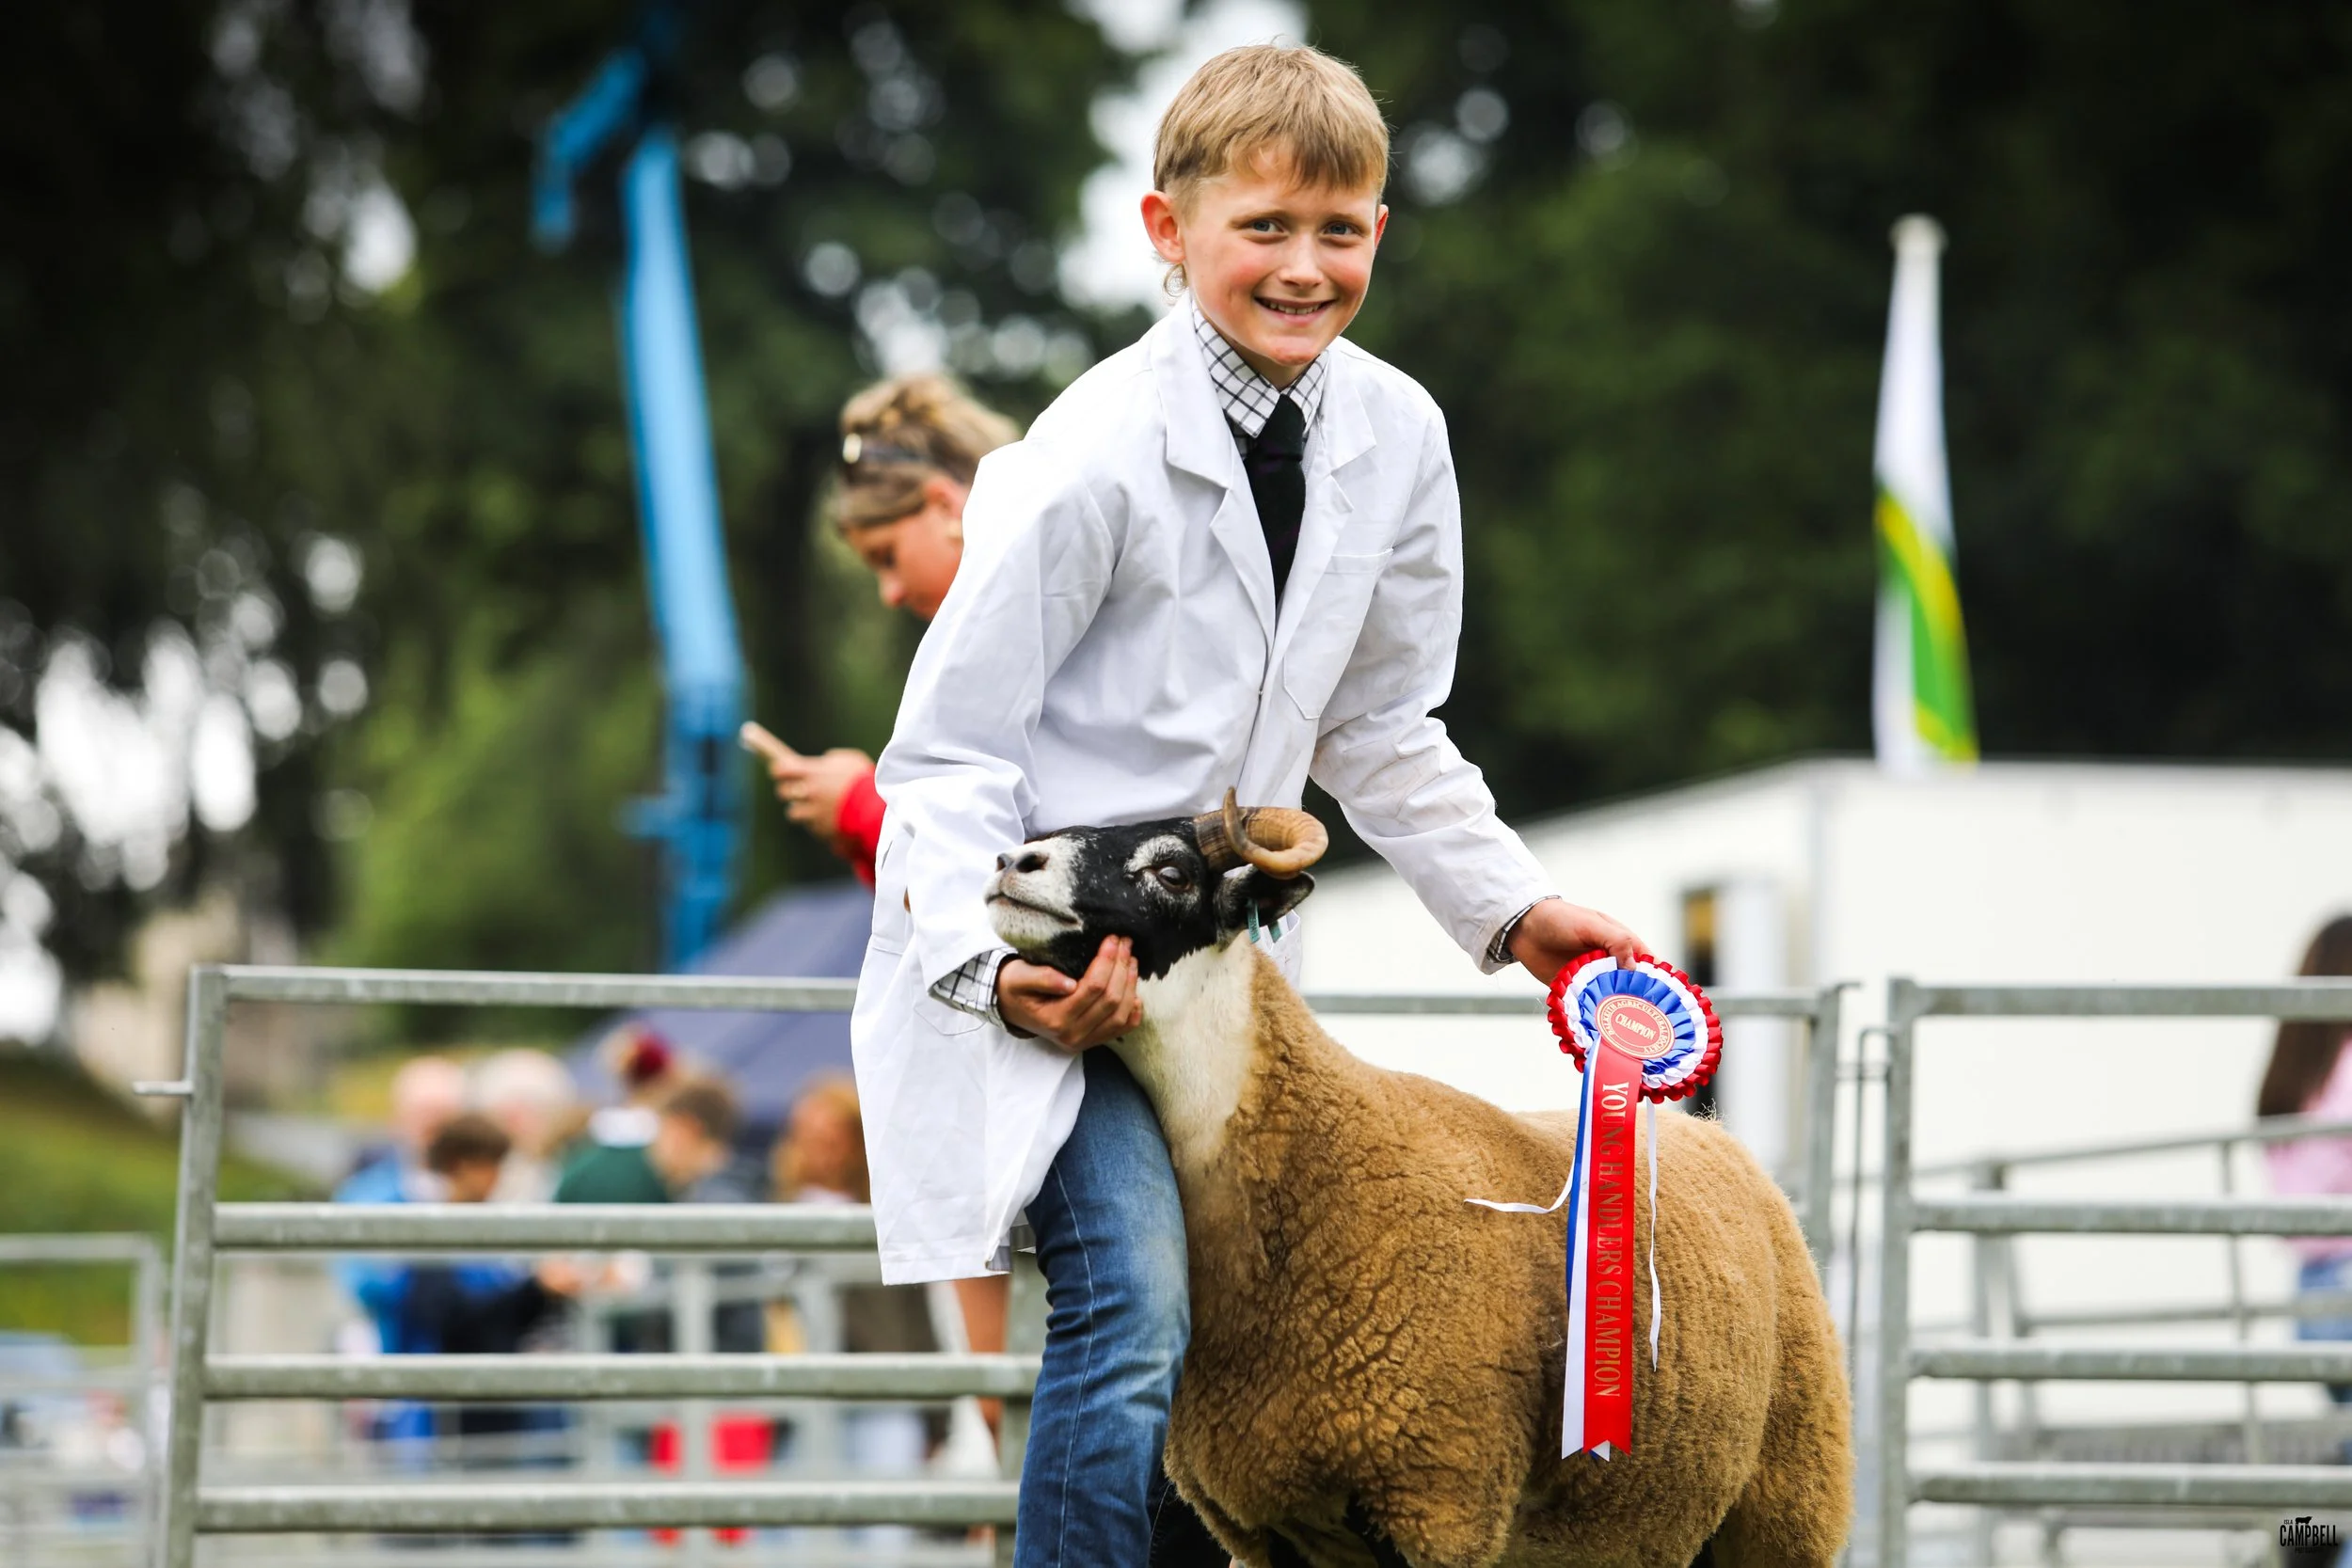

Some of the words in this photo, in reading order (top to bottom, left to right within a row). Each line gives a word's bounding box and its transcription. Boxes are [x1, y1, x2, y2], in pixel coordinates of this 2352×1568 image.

[1615, 1013, 1656, 1040] CHAMPION
[1616, 1000, 1669, 1034] AGRICULTURAL
[1643, 1034, 1669, 1053] SOCIETY
[1600, 1081, 1629, 1156] YOUNG
[1596, 1163, 1624, 1275] HANDLERS
[1594, 1280, 1621, 1398] CHAMPION
